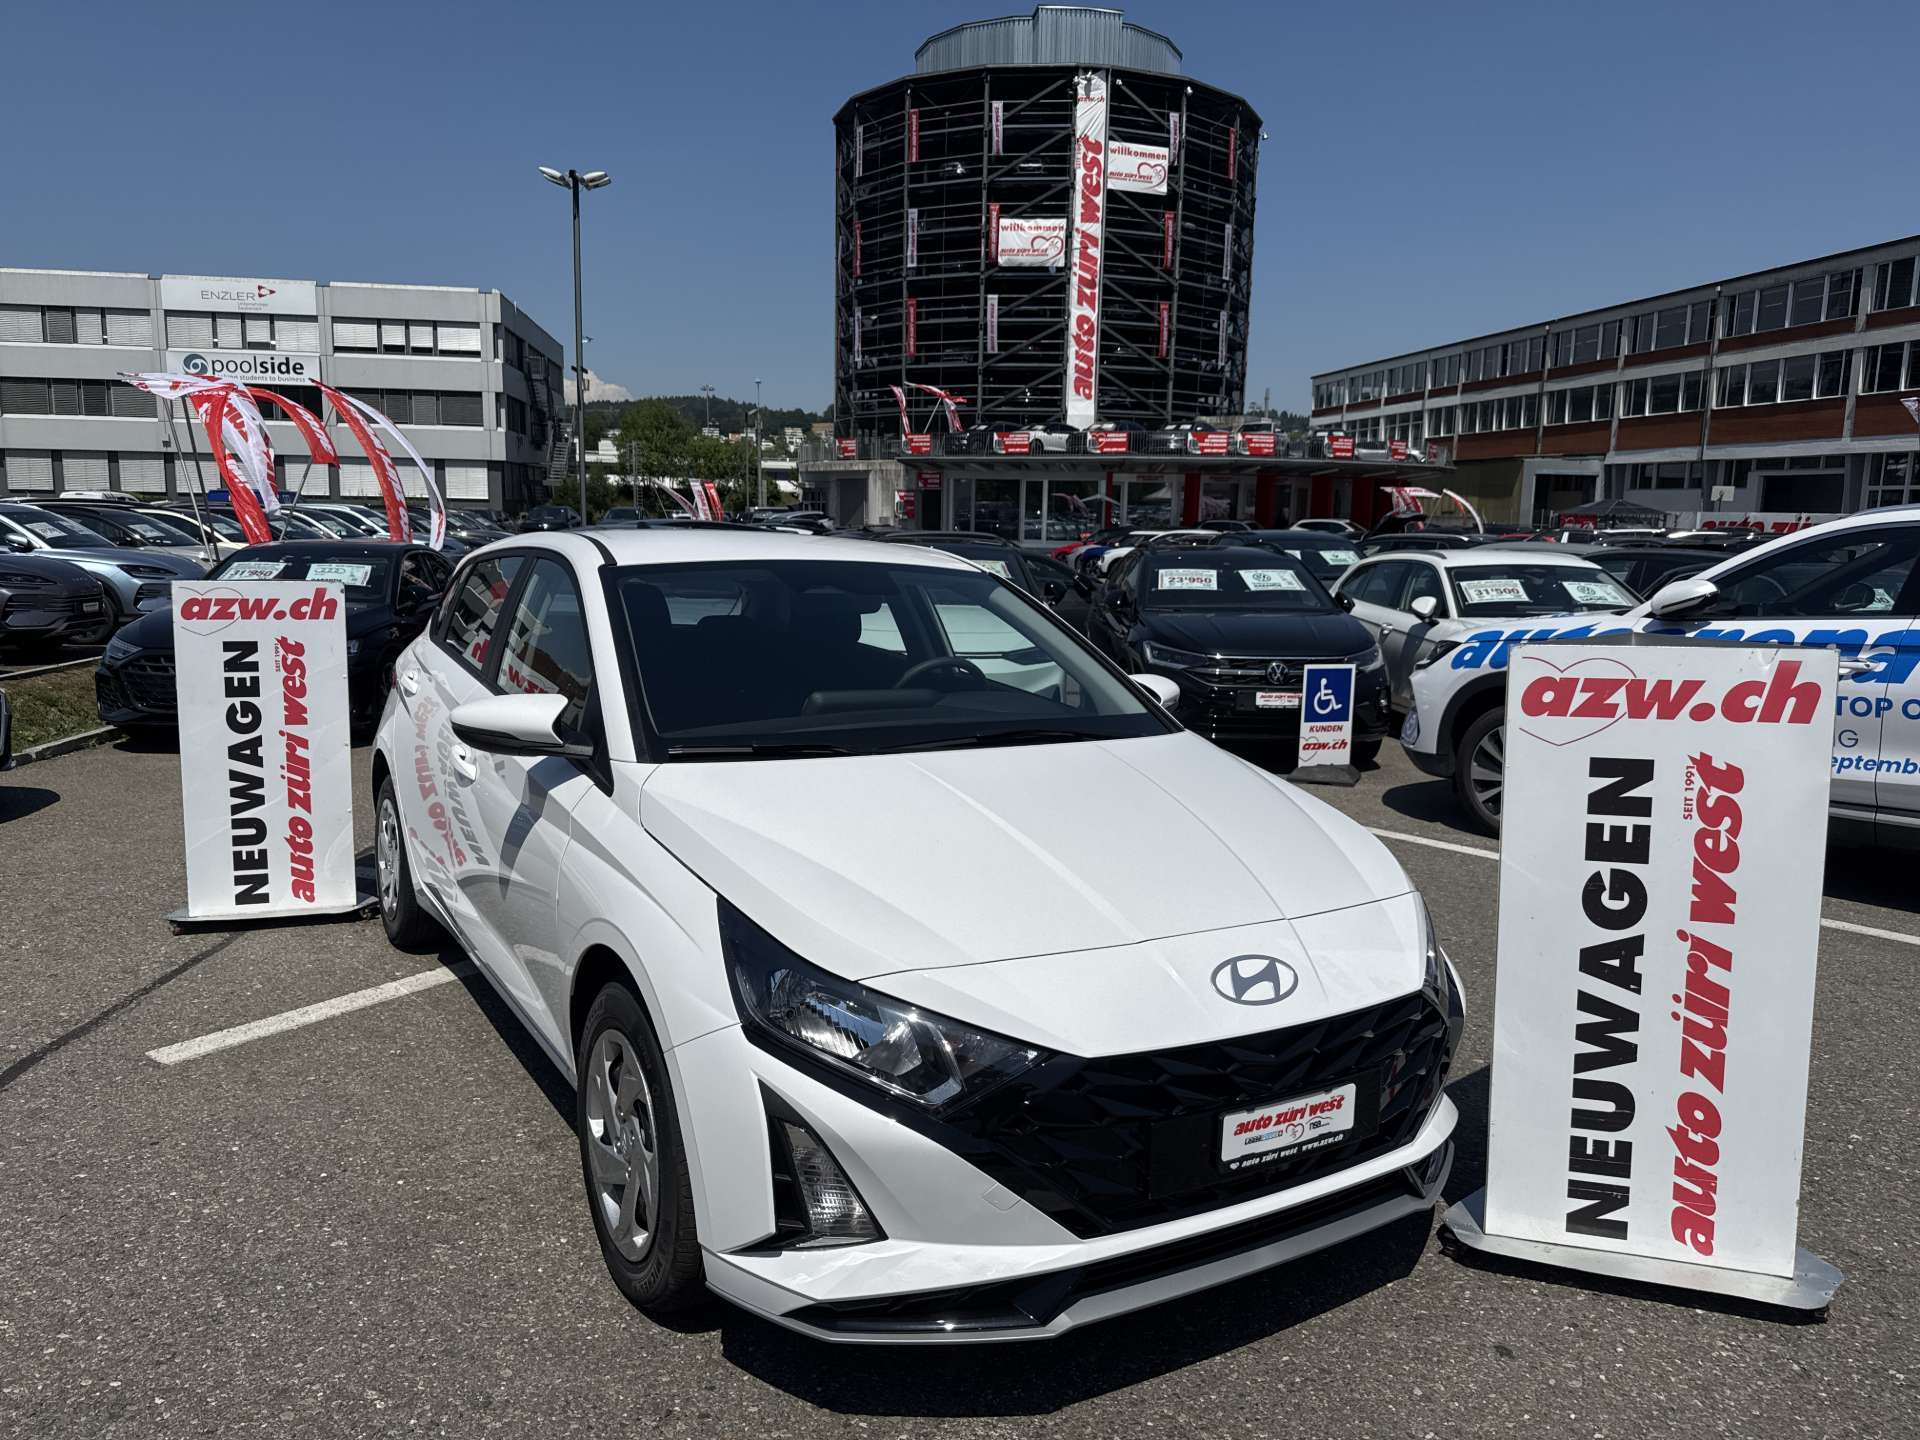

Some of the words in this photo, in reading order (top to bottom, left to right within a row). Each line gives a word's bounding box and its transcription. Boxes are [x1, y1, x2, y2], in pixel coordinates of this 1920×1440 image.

[1109, 145, 1167, 161] willkommen
[1079, 134, 1103, 224] west
[1001, 222, 1065, 232] willkommen
[1072, 226, 1100, 313] züri
[200, 290, 256, 301] ENZLER
[211, 355, 305, 375] poolside
[240, 374, 268, 382] students
[1072, 314, 1095, 401] auto
[1168, 576, 1212, 584] 23'950
[180, 588, 338, 621] azw.ch
[274, 635, 308, 726] west
[1521, 660, 1822, 725] azw.ch
[1302, 739, 1348, 751] azw.ch
[1308, 724, 1344, 734] KUNDEN
[222, 640, 270, 906] NEUWAGEN
[278, 729, 312, 814] züri
[1685, 764, 1696, 792] 1991
[1683, 796, 1694, 820] SEIT
[1686, 751, 1745, 924] west
[283, 816, 315, 903] auto
[1565, 756, 1655, 1241] NEUWAGEN
[1670, 928, 1734, 1094] züri
[1234, 1114, 1272, 1136] auto
[1273, 1103, 1309, 1127] züri
[1309, 1094, 1345, 1117] west
[1241, 1157, 1260, 1168] auto
[1261, 1151, 1279, 1163] züri
[1280, 1146, 1298, 1157] west
[1665, 1092, 1723, 1257] auto
